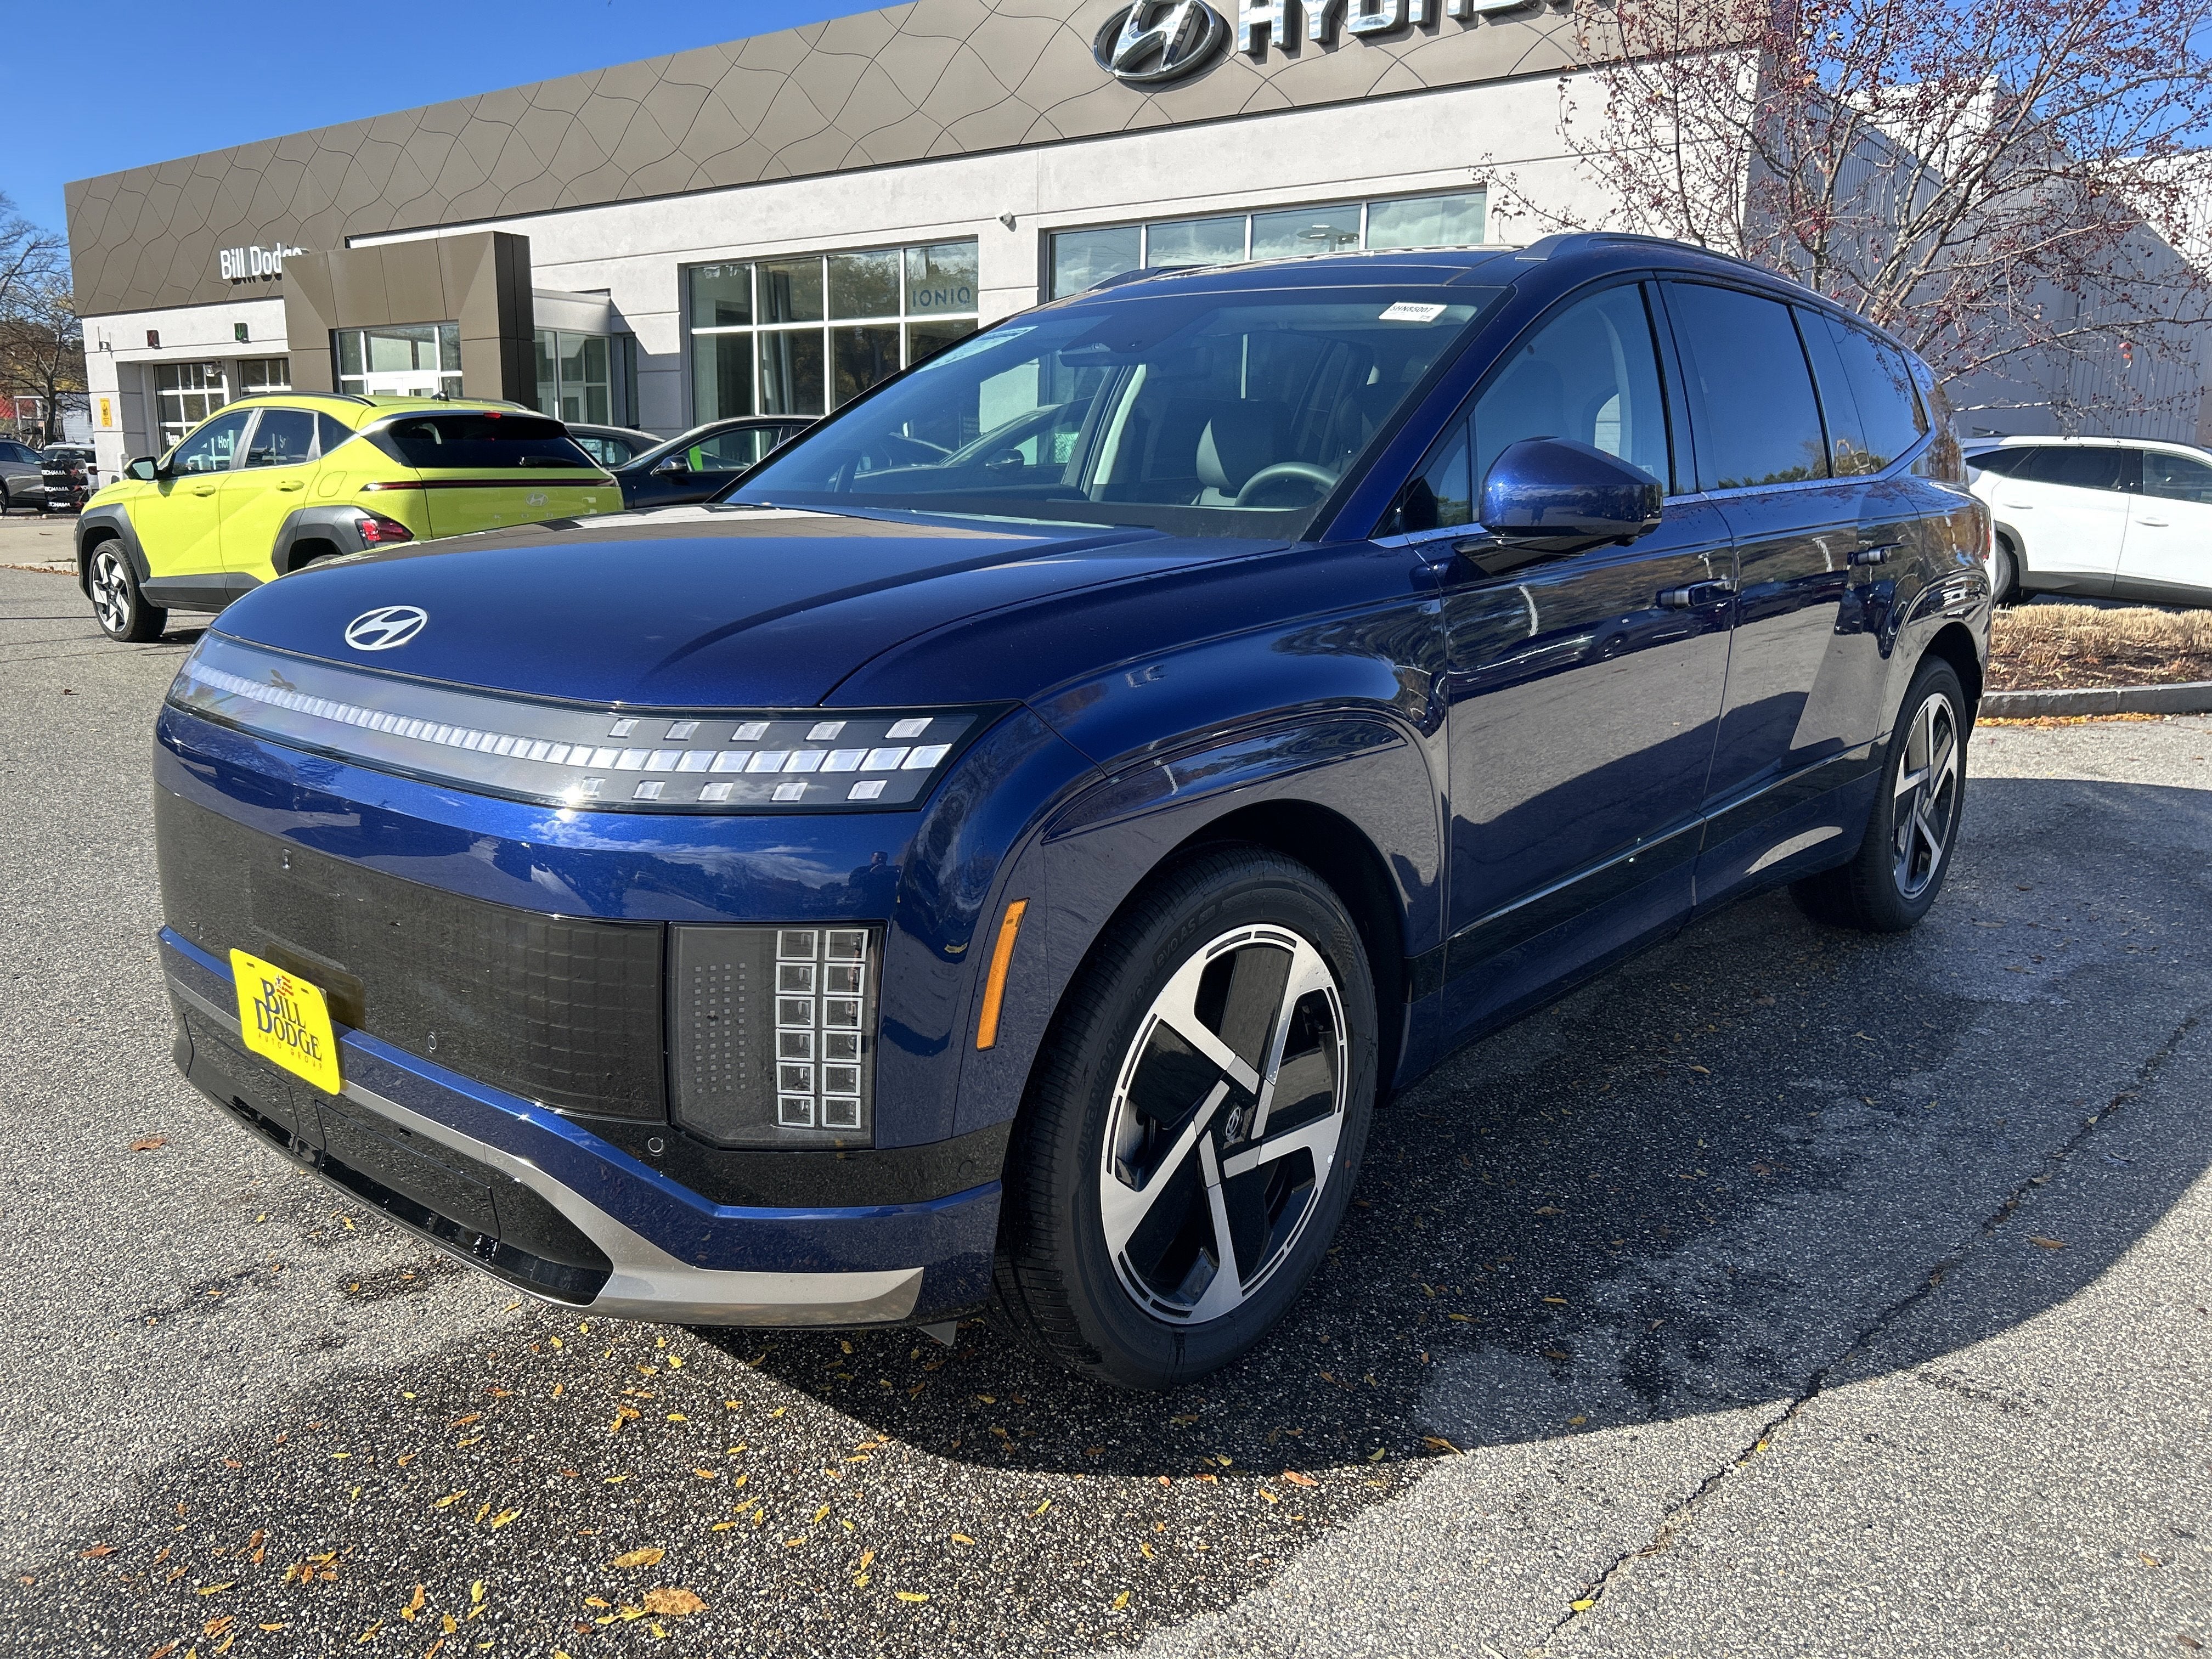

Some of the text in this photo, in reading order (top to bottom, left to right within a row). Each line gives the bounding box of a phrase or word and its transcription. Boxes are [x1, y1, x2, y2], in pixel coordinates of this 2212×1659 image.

[220, 242, 302, 279] Bill Dod
[913, 286, 970, 307] IONIQ
[260, 978, 306, 1030] BILL
[253, 996, 323, 1060] DODGE
[258, 1032, 323, 1070] AUTO GROUP
